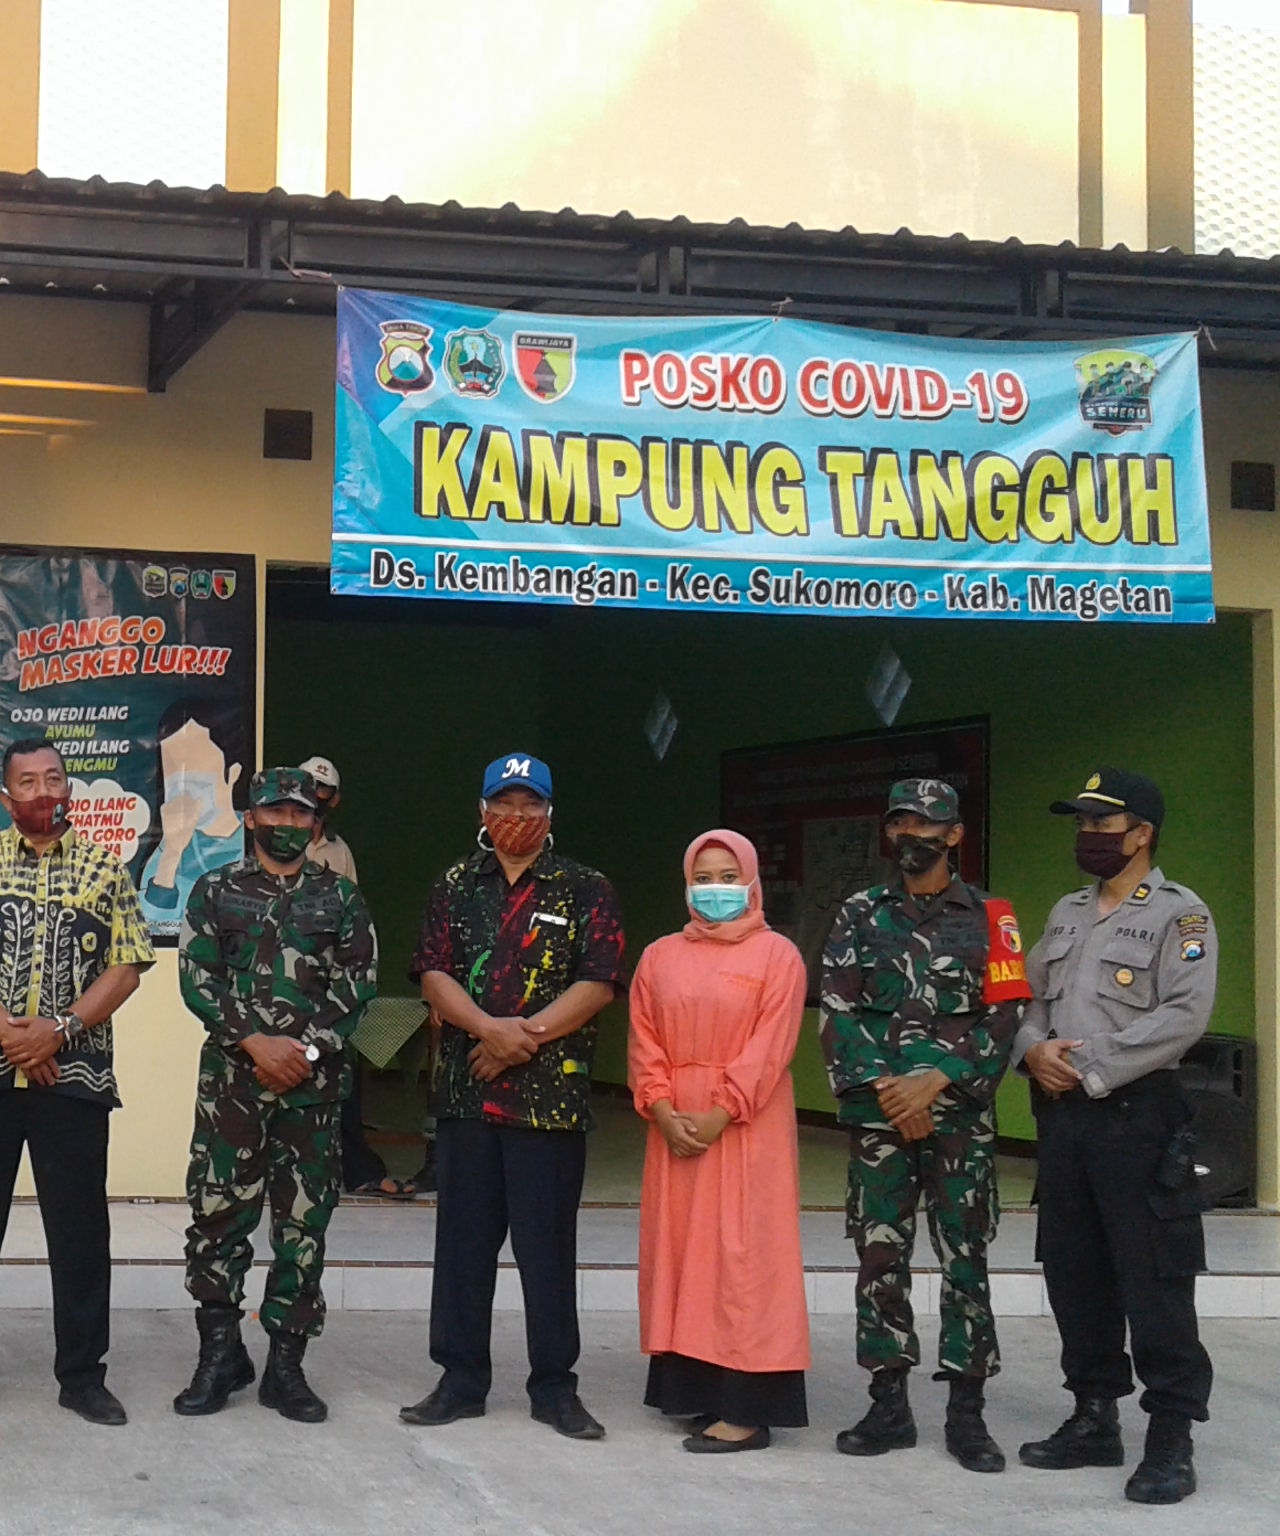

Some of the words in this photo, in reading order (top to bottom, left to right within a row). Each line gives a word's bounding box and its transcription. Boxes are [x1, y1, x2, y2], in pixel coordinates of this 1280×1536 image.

[621, 351, 787, 413] POSKO
[796, 357, 1029, 424] COVID-19
[414, 420, 810, 537] KAMPUNG
[821, 443, 1178, 546] TANGGUH
[371, 550, 425, 589] Ds.
[434, 551, 639, 604] Kembangan
[666, 563, 740, 603] Kec.
[748, 567, 917, 610] Sukomoro
[944, 574, 1020, 612] Kab.
[1028, 576, 1172, 621] Magetan
[17, 615, 165, 660] NGANGGO
[19, 647, 138, 692] MASKER
[142, 646, 231, 676] LUR!!!
[11, 708, 43, 723] OJO
[47, 706, 84, 722] WEDI
[85, 705, 128, 721] ILANG
[86, 739, 130, 755] ILANG
[64, 757, 118, 773] ENGMU
[501, 757, 531, 779] M
[94, 797, 137, 811] ILANG
[92, 827, 136, 842] GORO
[1115, 926, 1155, 942] POLRI
[988, 959, 1027, 984] BAB
